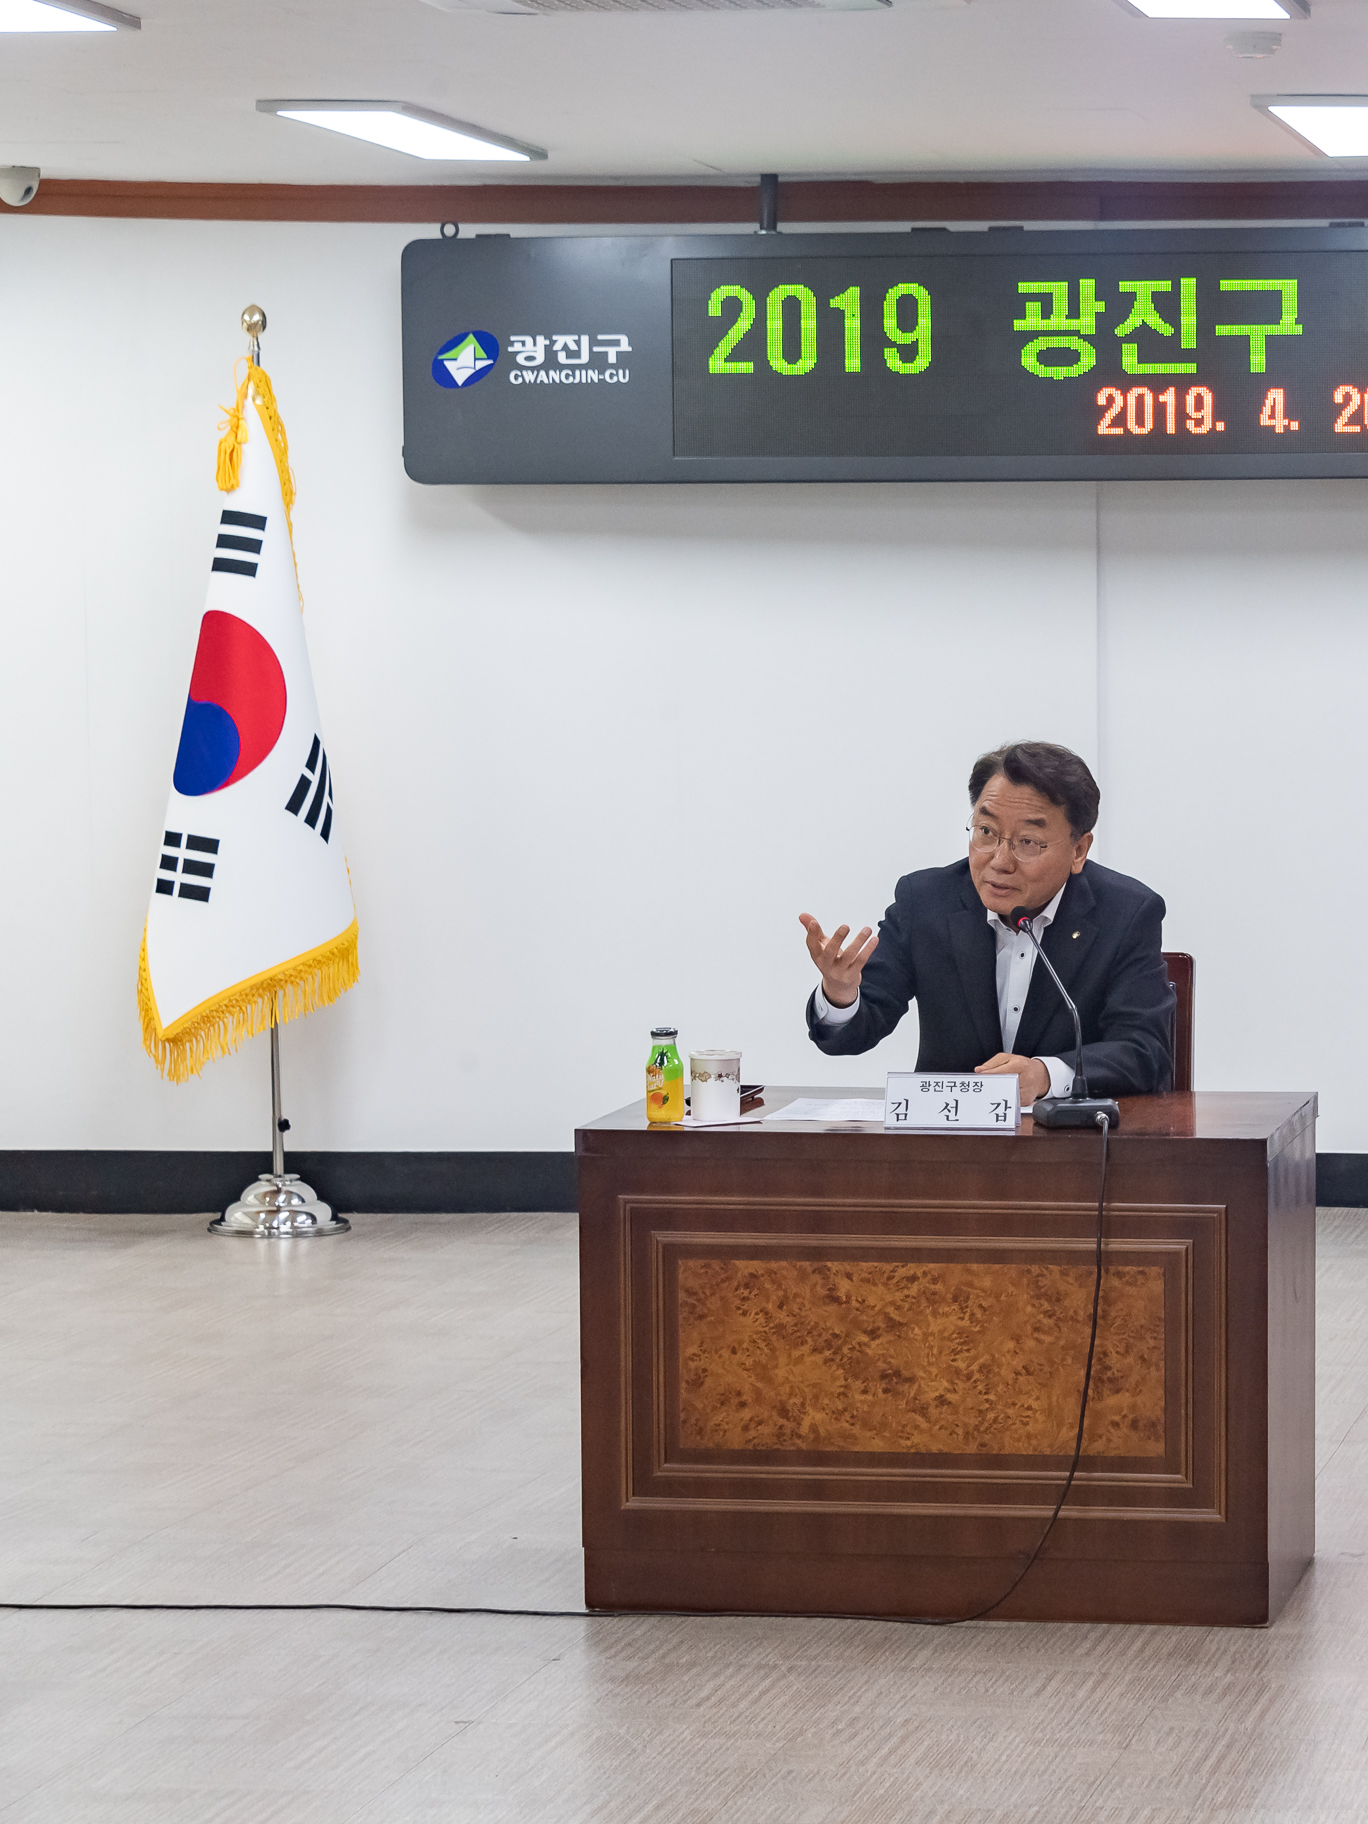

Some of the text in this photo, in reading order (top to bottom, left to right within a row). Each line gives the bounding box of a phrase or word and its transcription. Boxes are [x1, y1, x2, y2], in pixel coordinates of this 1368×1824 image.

[708, 282, 933, 376] 2019
[1013, 276, 1303, 380] 광진구
[507, 334, 633, 367] 광진구
[508, 368, 630, 385] GWANGJIN-GU
[1096, 386, 1226, 435] 2019.
[1259, 387, 1300, 434] 4.
[919, 1080, 985, 1093] 광진구청장
